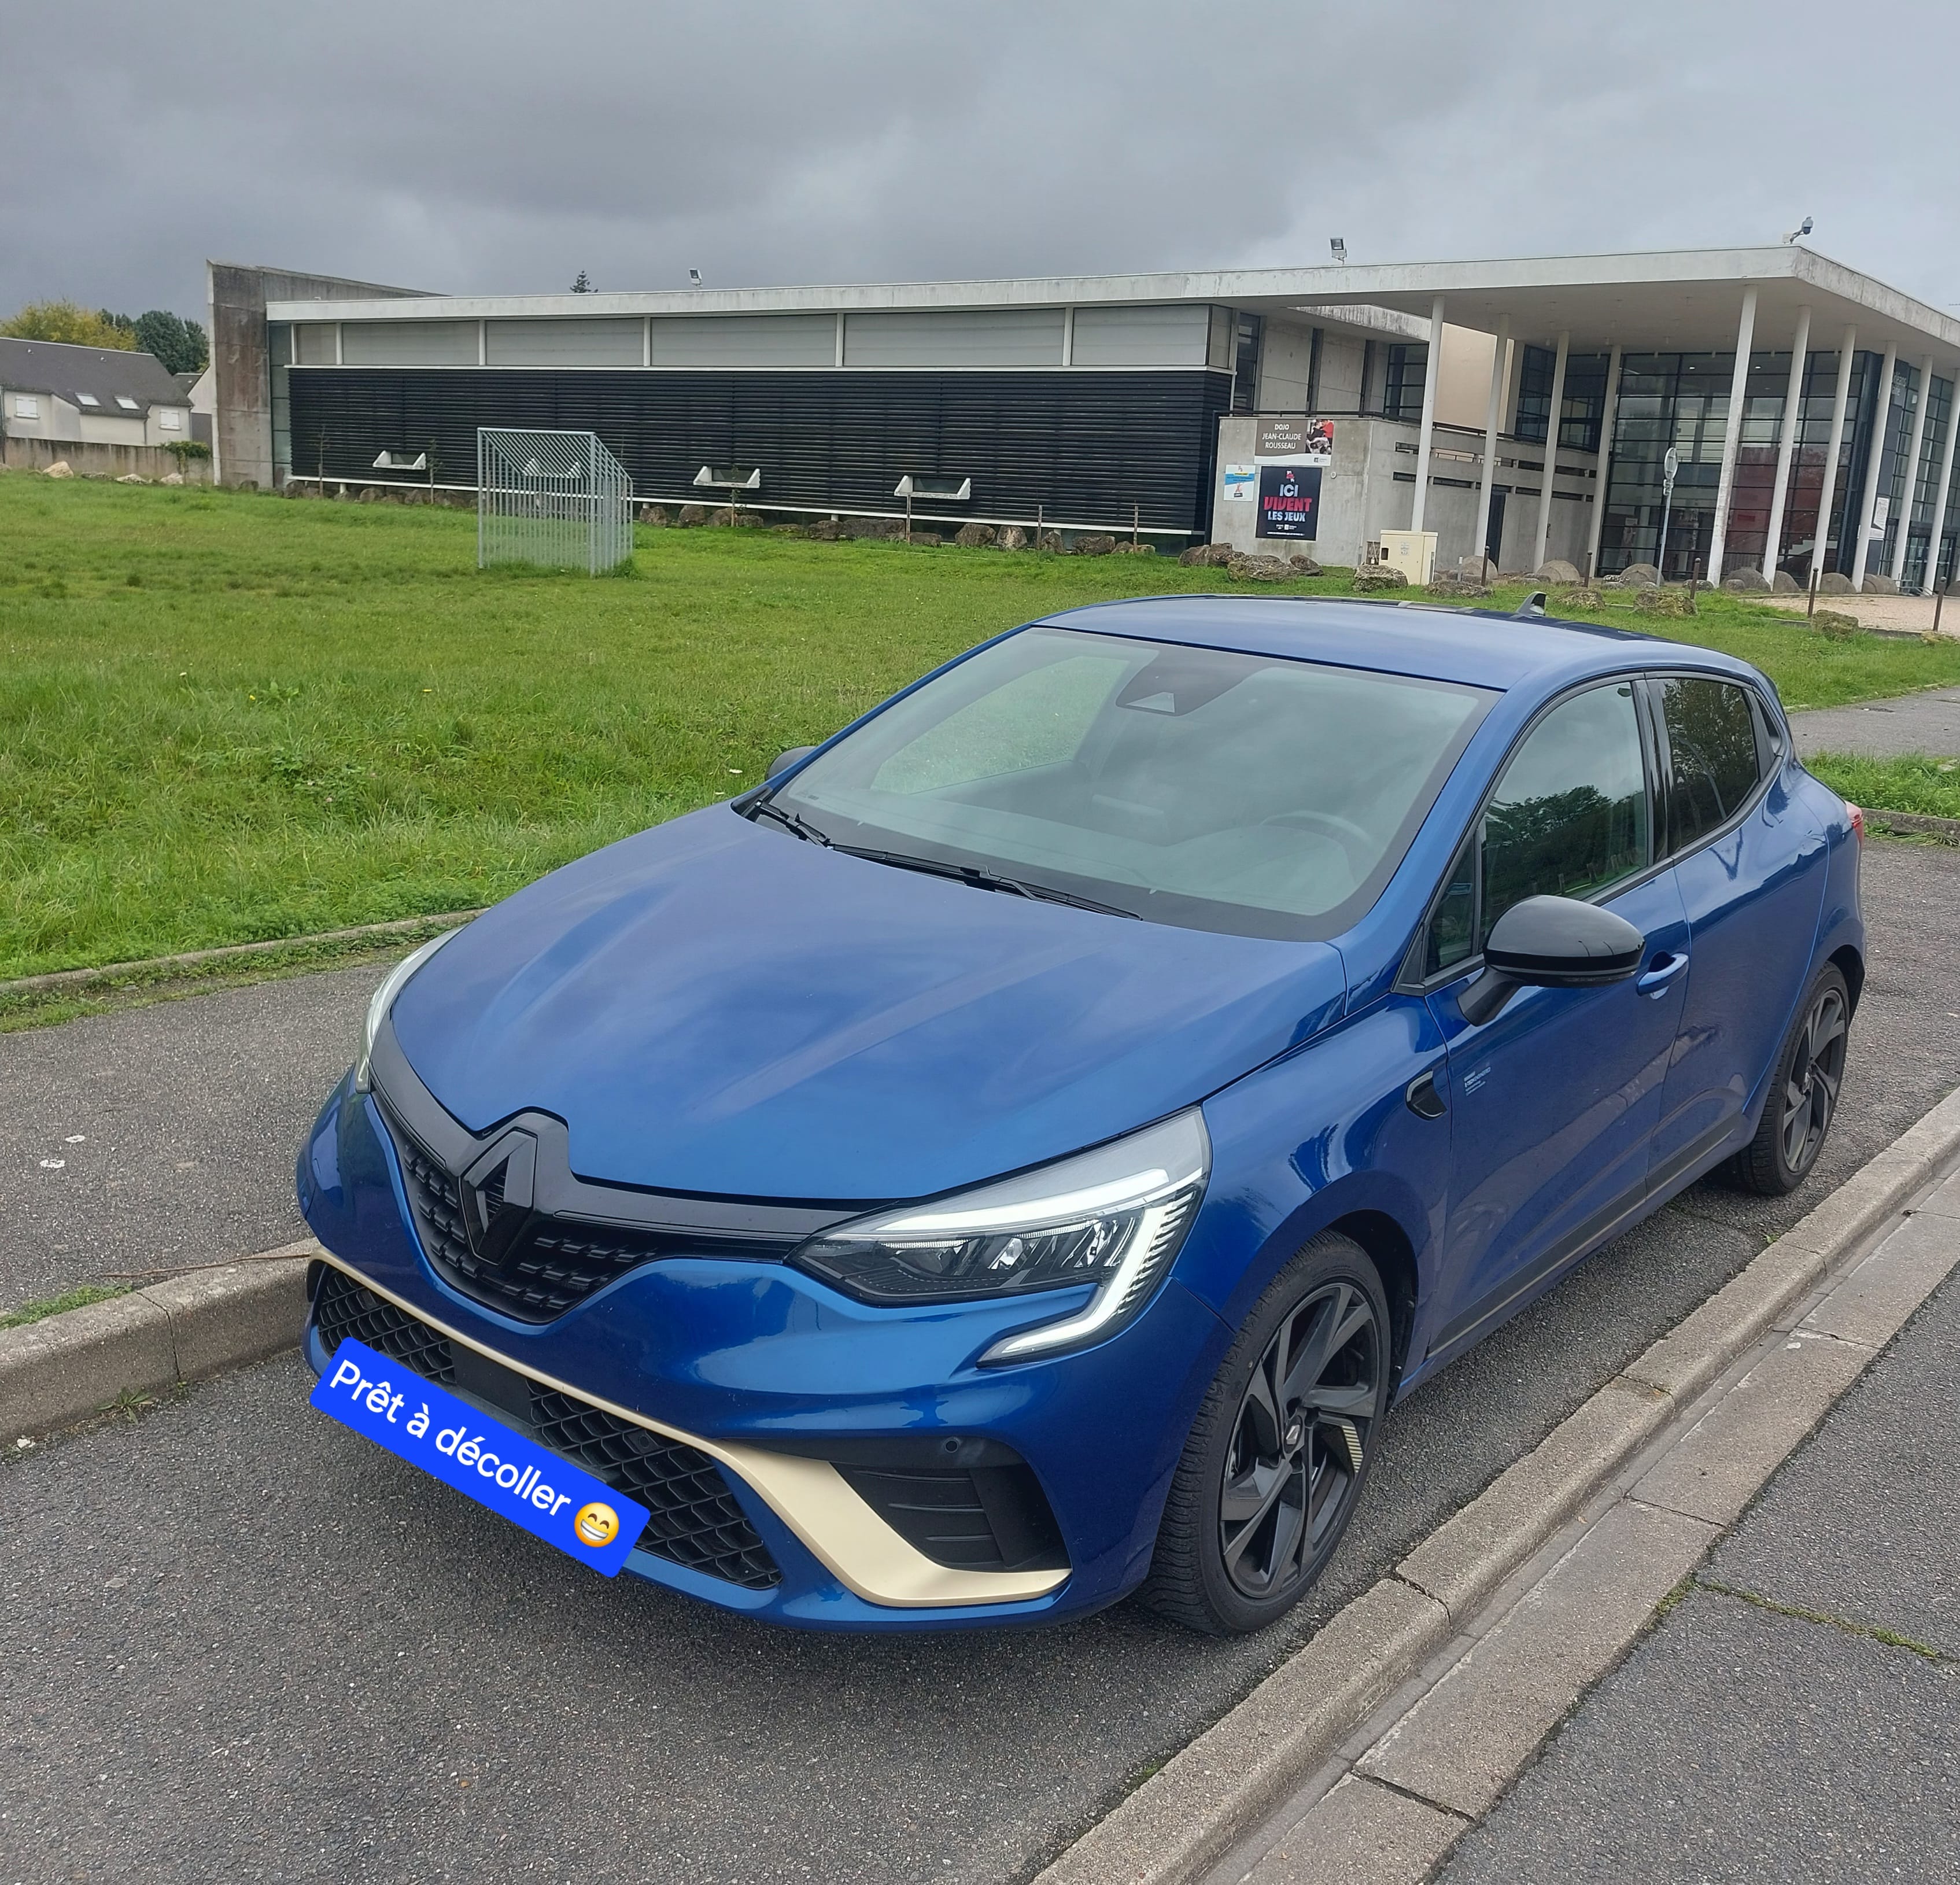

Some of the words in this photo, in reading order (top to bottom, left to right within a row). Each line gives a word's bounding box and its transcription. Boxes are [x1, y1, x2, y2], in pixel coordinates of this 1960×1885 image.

[1262, 432, 1302, 440] JEAN-CLAUDE
[1279, 484, 1298, 497] ICI
[1264, 496, 1312, 512] VIVENT
[1268, 511, 1283, 521] LES
[1284, 512, 1305, 522] JEUX
